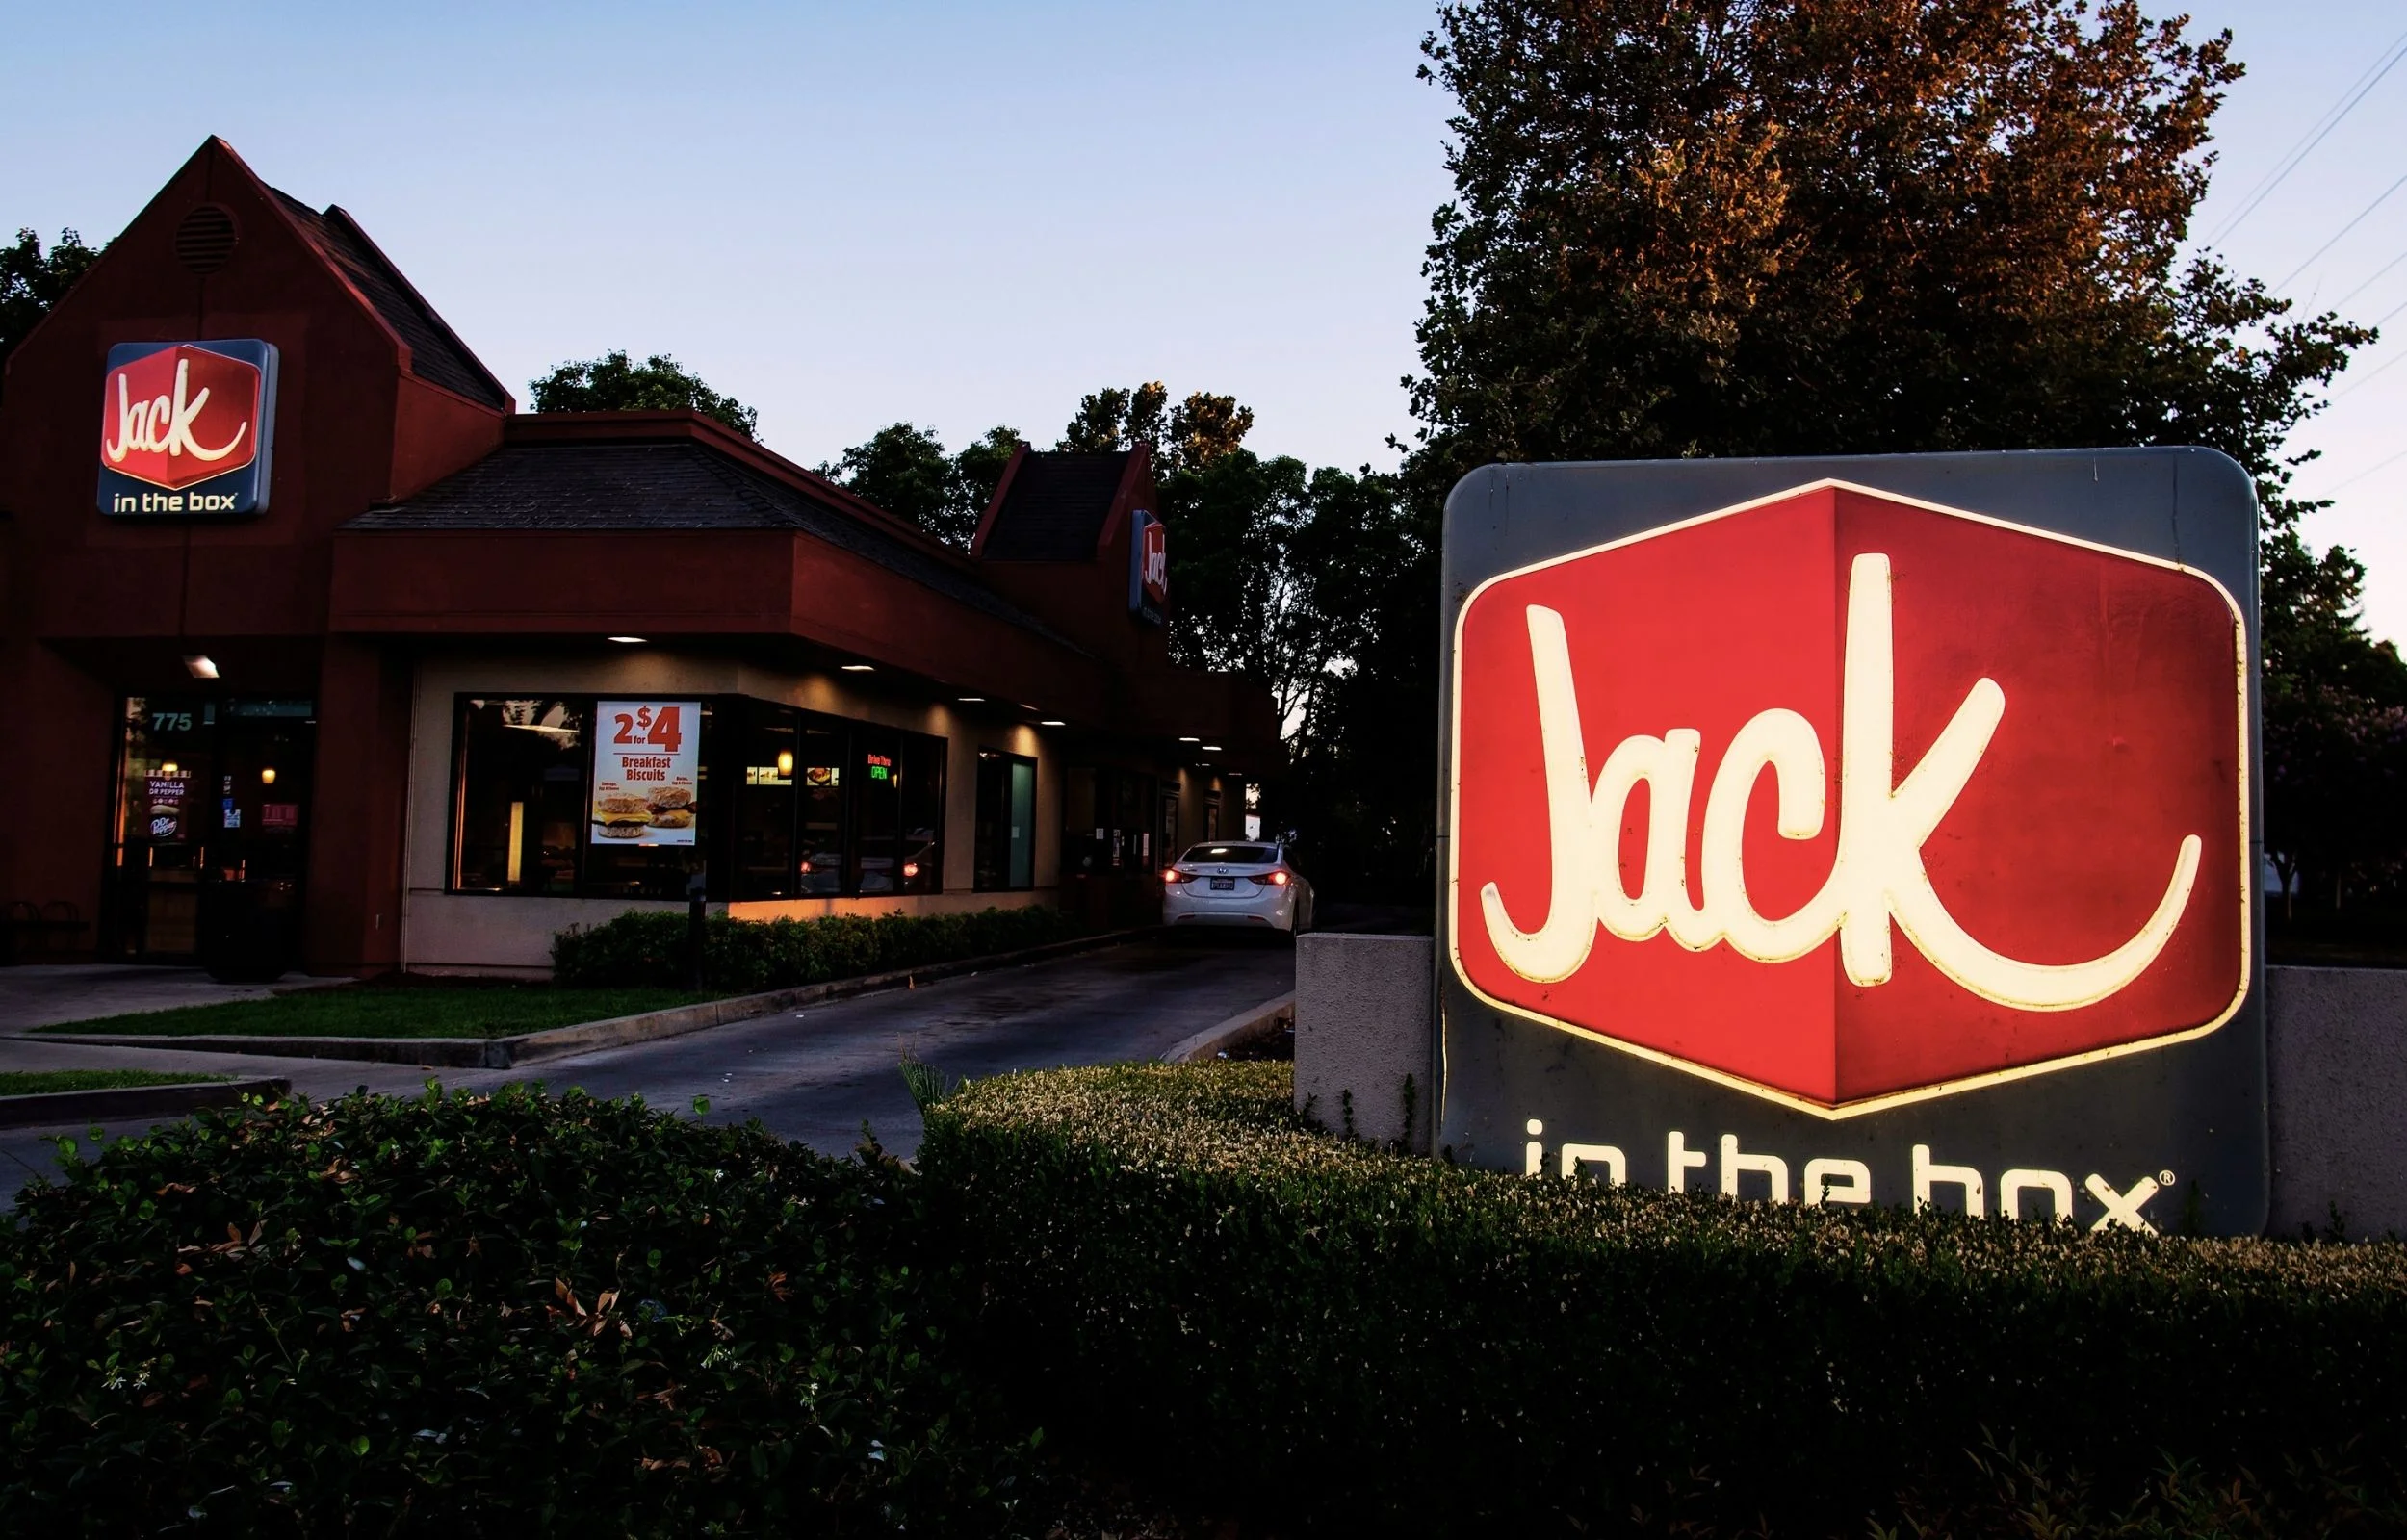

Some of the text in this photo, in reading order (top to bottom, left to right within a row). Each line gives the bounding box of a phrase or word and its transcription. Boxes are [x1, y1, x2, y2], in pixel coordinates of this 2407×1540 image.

[106, 358, 247, 462] Jack
[114, 493, 137, 513] in
[142, 492, 183, 512] the
[152, 713, 192, 732] 775
[613, 713, 634, 744] 2
[634, 735, 646, 744] for
[622, 756, 671, 769] Breakfast
[871, 766, 888, 779] OPEN
[626, 769, 665, 781] Biscuits
[1480, 552, 2202, 1012] Jack
